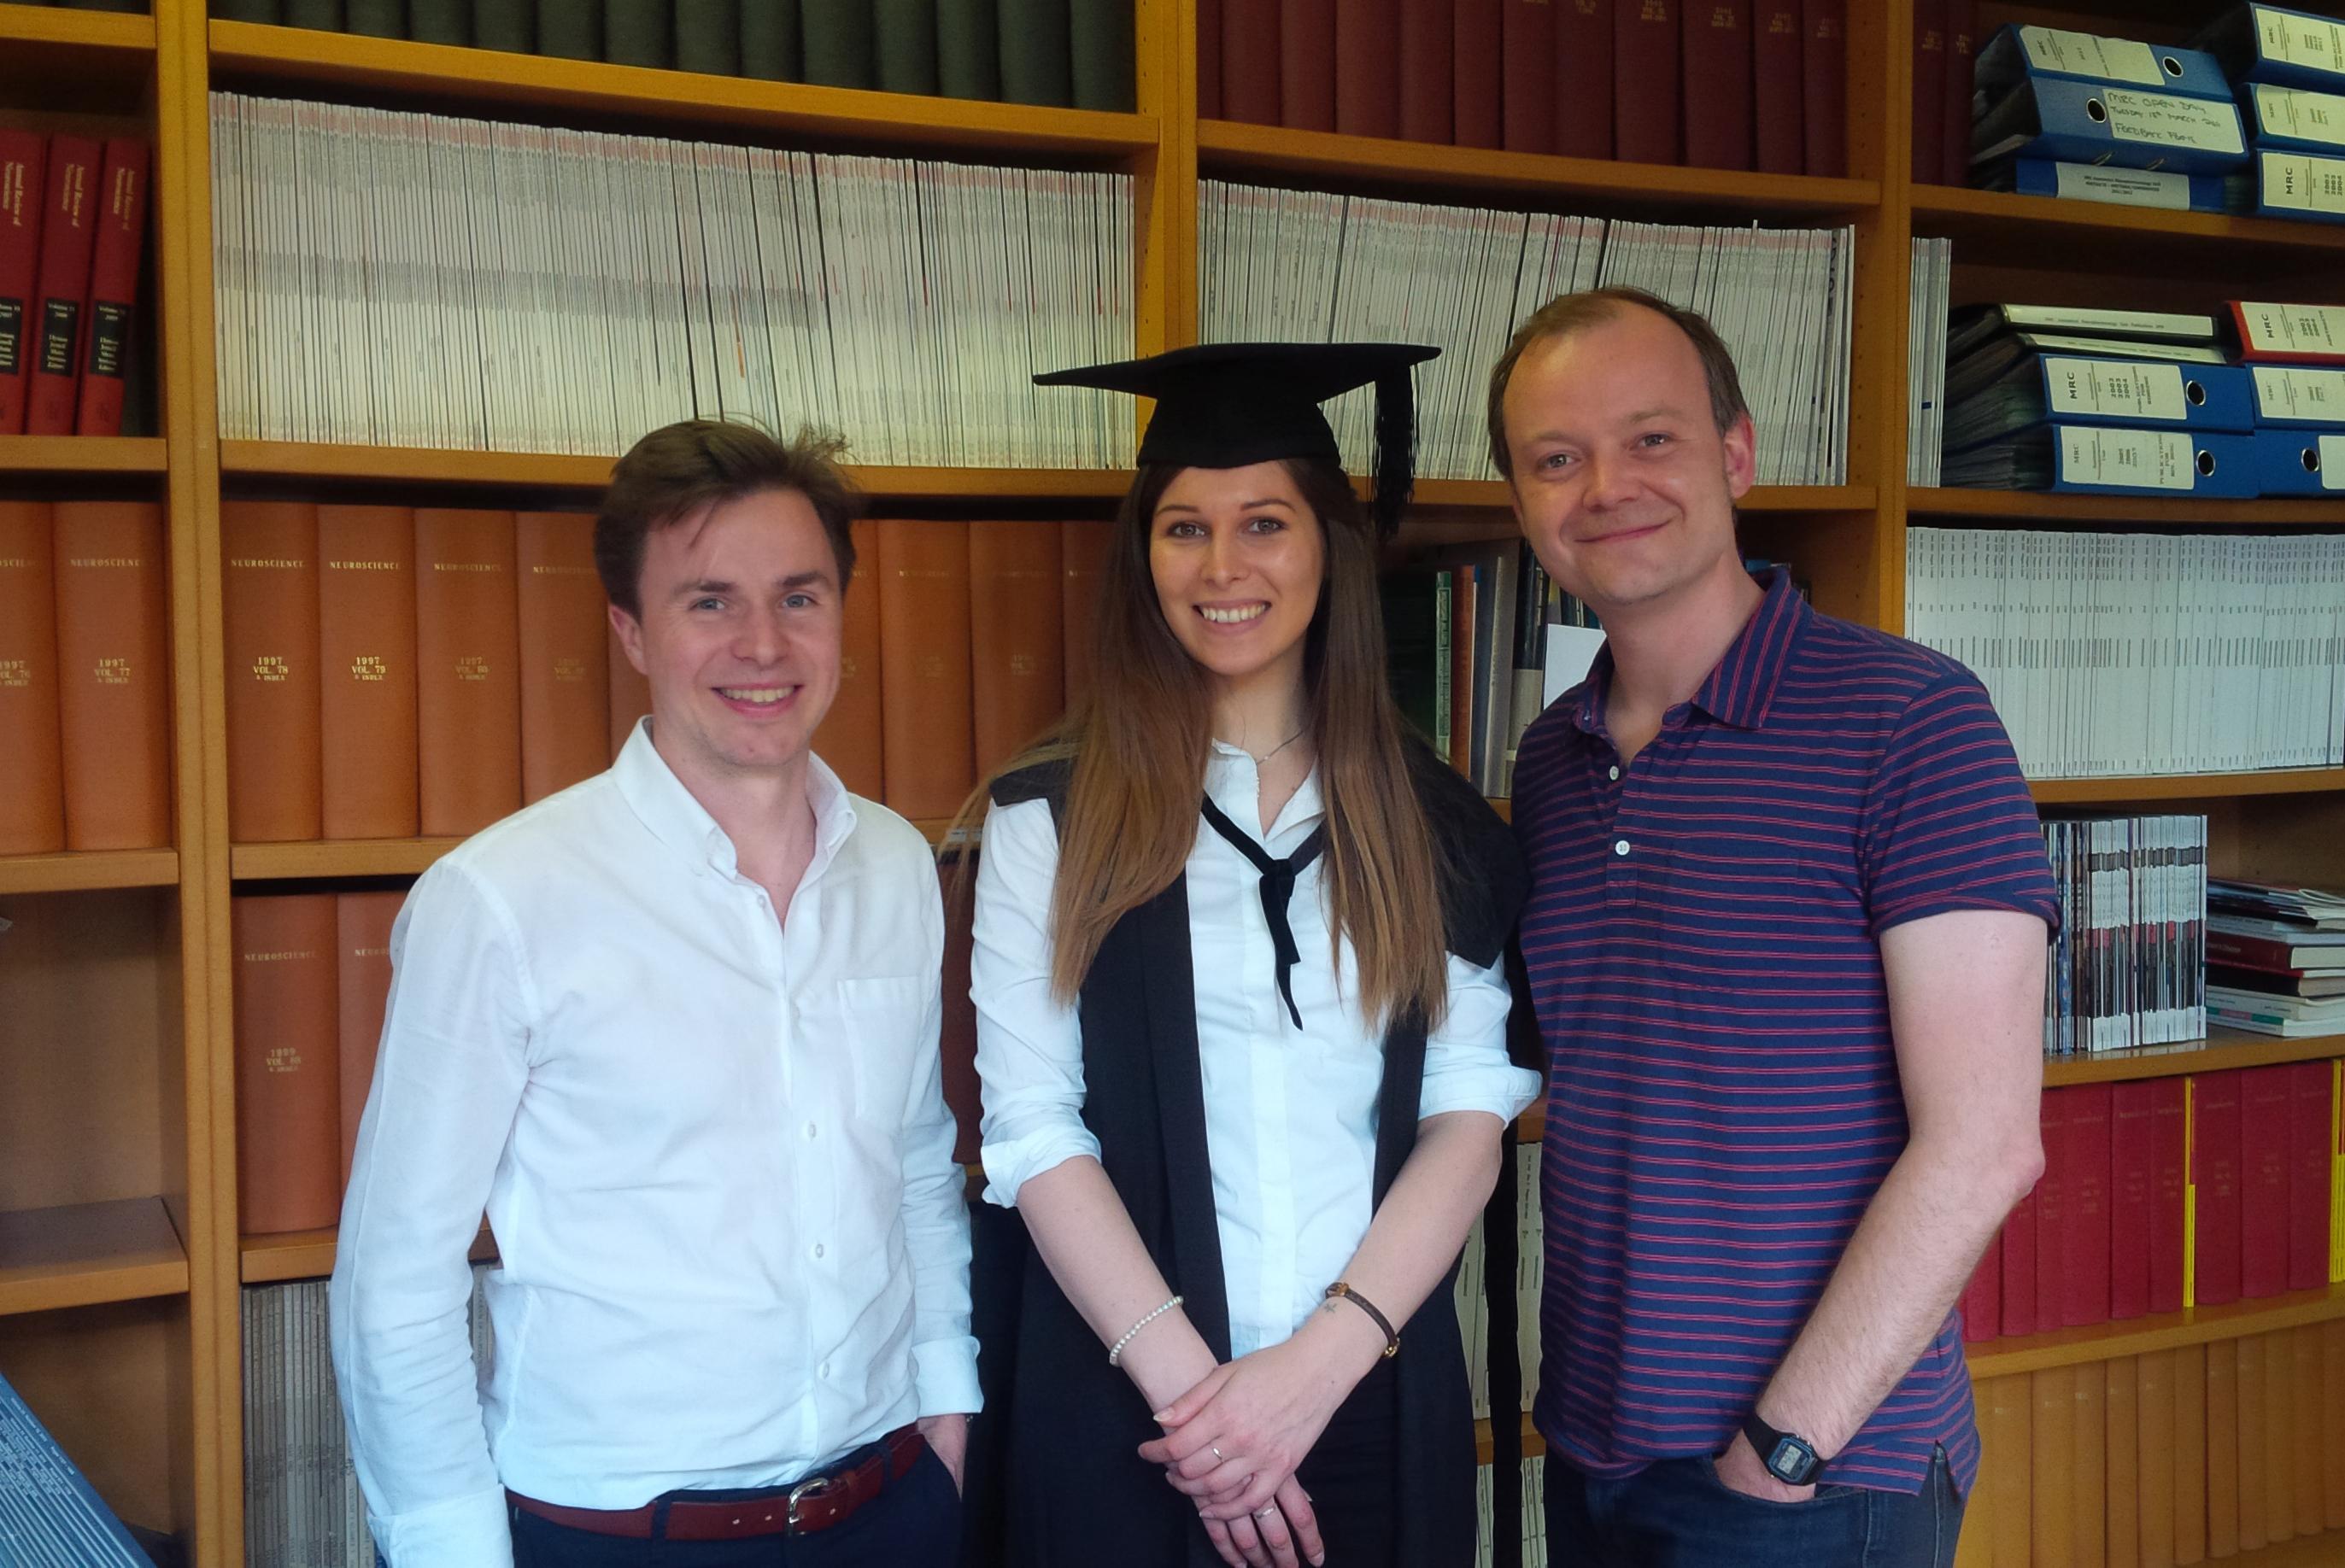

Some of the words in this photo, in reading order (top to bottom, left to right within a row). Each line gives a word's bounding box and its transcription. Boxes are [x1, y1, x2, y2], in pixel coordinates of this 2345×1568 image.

[2108, 92, 2137, 105] MRC
[2285, 167, 2294, 195] MRC
[2261, 313, 2275, 339] MRC
[2067, 372, 2078, 400] MRC
[70, 559, 142, 568] NEUROSCIENC
[231, 559, 305, 568] NEUROSCIENCE
[99, 658, 125, 668] 1997
[258, 657, 283, 666] 1997
[356, 656, 380, 666] 1997
[278, 665, 289, 674] 78
